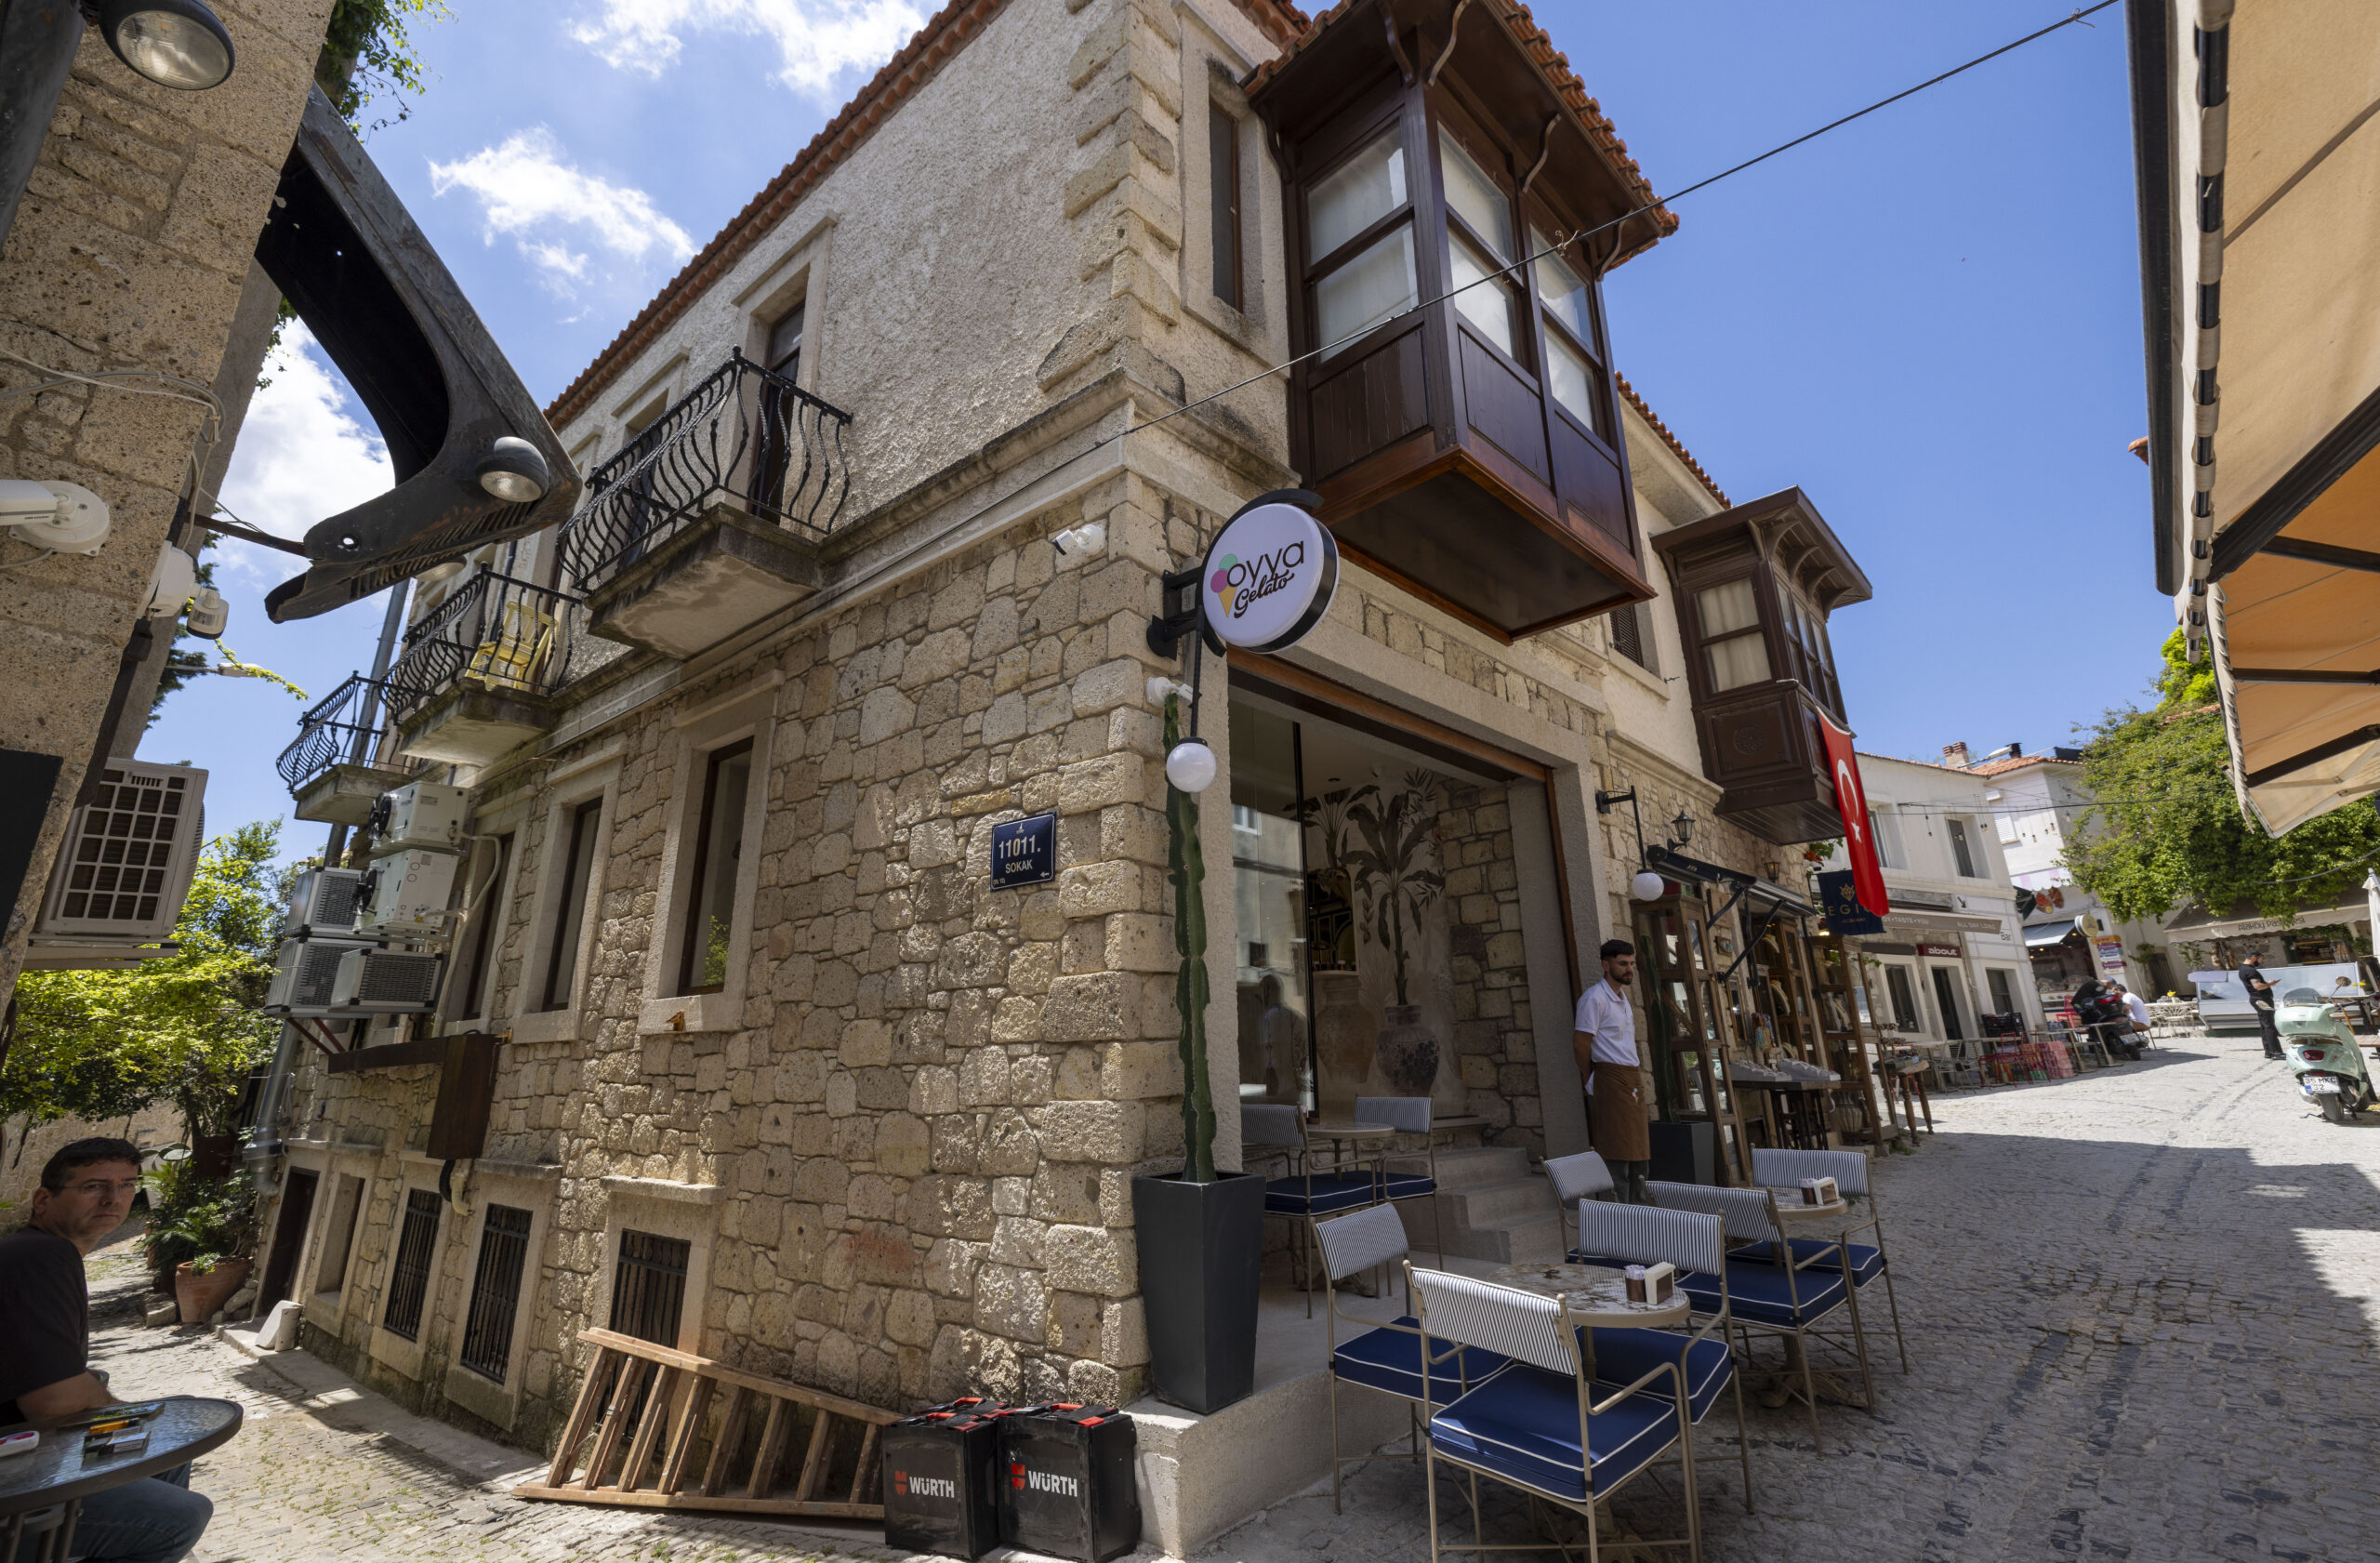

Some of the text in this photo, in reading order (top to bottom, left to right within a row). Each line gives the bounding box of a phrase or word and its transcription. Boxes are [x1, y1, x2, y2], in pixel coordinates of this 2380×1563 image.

[1226, 540, 1304, 588] oyya
[1234, 569, 1294, 618] Gelato
[998, 834, 1041, 859] 11011.
[1005, 858, 1033, 874] SOKAK
[1927, 947, 1957, 956] about
